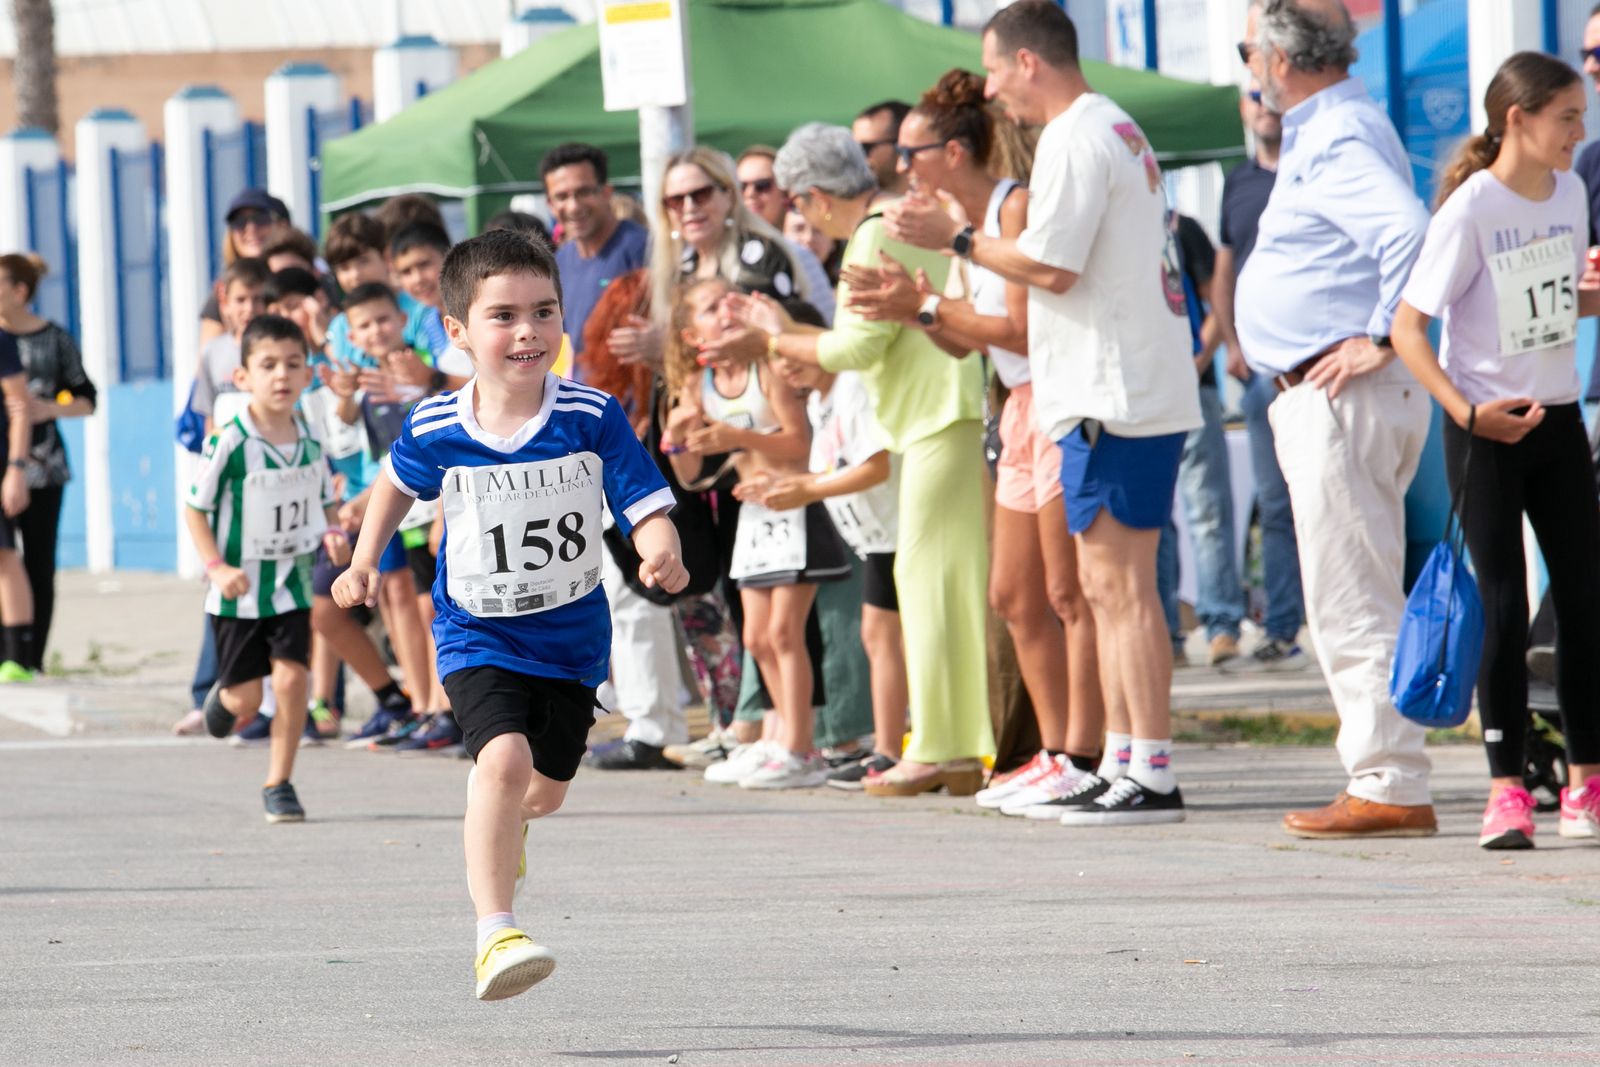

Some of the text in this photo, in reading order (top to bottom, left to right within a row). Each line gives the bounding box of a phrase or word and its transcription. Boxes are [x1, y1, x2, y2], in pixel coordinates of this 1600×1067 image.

[1524, 275, 1575, 320] 175
[487, 459, 592, 494] MILLA
[524, 491, 541, 500] DE
[545, 488, 559, 498] LA
[272, 497, 310, 534] 121
[484, 511, 587, 575] 158
